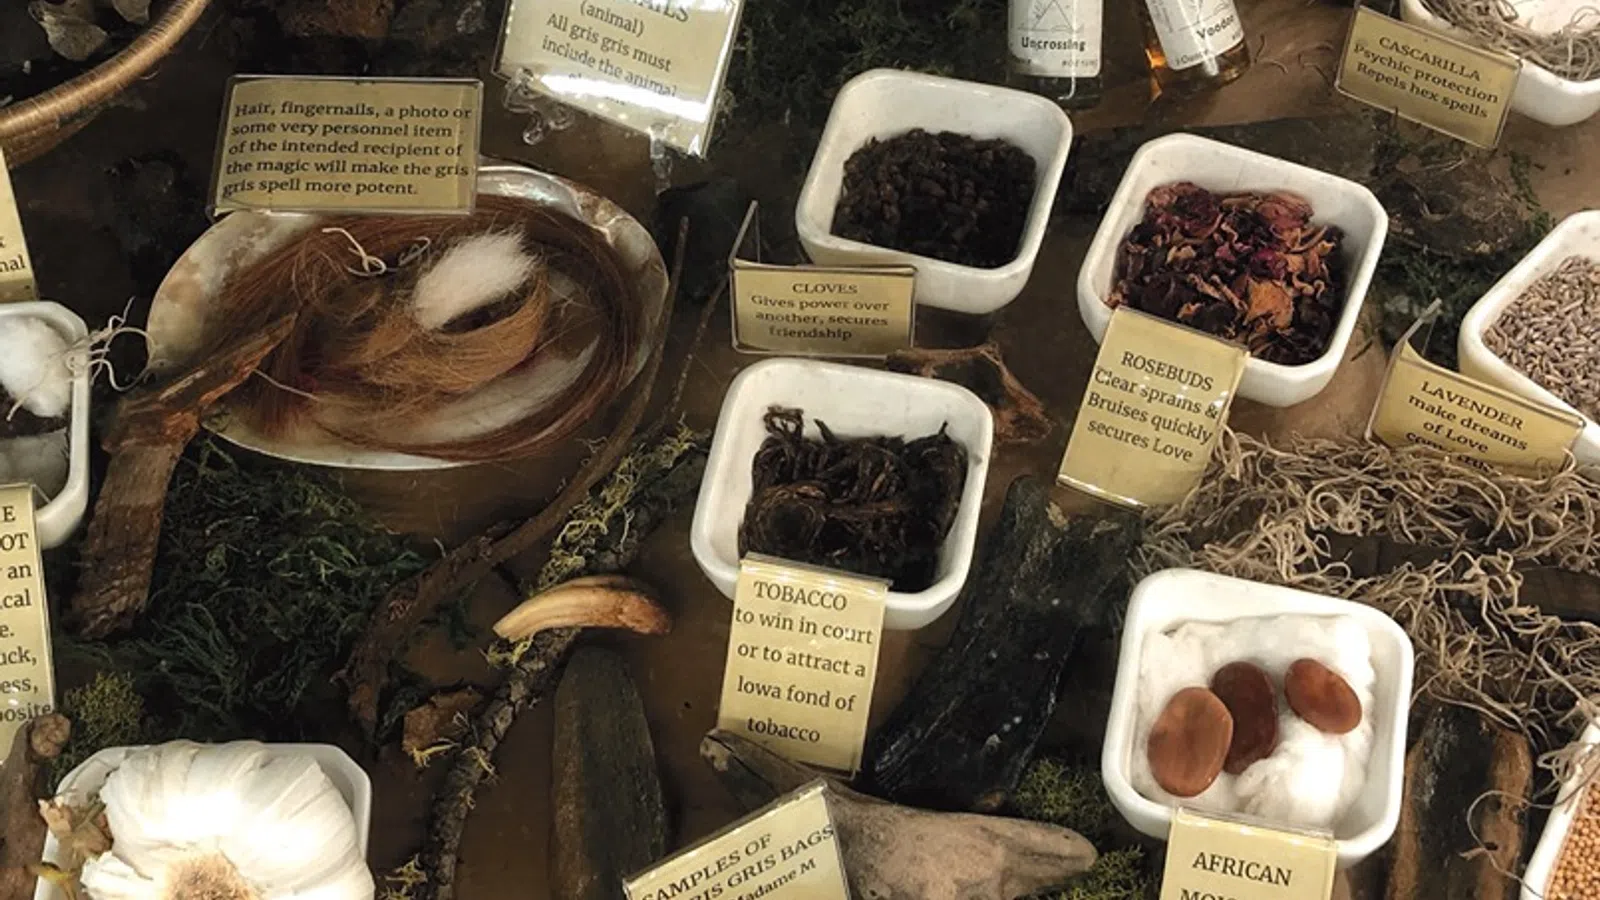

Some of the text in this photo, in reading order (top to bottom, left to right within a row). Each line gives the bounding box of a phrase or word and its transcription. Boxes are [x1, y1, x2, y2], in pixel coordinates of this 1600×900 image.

[579, 0, 645, 37] (animal)
[547, 13, 672, 72] All gris gris must
[1021, 36, 1086, 52] Uncrossing
[542, 36, 677, 98] include the animal
[1379, 36, 1481, 81] CASCARILLA
[1354, 44, 1498, 103] Psychic protection
[1356, 62, 1488, 118] Repels hex spells
[235, 101, 472, 119] Hair, fingernails, a photo or
[231, 123, 452, 141] some very personnel item
[228, 140, 462, 158] of the intended recipient of
[226, 159, 468, 178] the magic will make the gris
[222, 177, 418, 198] gris spell more potent.
[751, 294, 890, 311] Gives power over
[792, 283, 858, 294] CLOVES
[756, 310, 888, 326] another, secures
[769, 325, 852, 341] friendship
[1121, 351, 1214, 392] ROSEBUDS
[1094, 368, 1218, 420] Clear sprains &
[1421, 381, 1524, 430] LAVENDER
[1087, 392, 1213, 446] Bruises quickly
[1408, 394, 1528, 451] make dreams
[1087, 420, 1193, 462] secures Love
[1423, 420, 1488, 453] of Love
[0, 532, 29, 551] OT
[7, 564, 32, 579] an
[0, 588, 31, 609] cal
[754, 581, 848, 610] TOBACCO
[735, 608, 873, 644] to win in court
[738, 643, 866, 678] or to attract a
[0, 702, 51, 722] osite
[786, 685, 830, 708] fond
[835, 695, 856, 712] of
[747, 718, 820, 742] tobacco
[728, 855, 776, 888] GRIS
[782, 824, 834, 862] BAGS
[744, 833, 773, 856] OF
[801, 858, 817, 874] M
[1192, 852, 1292, 886] AFRICAN
